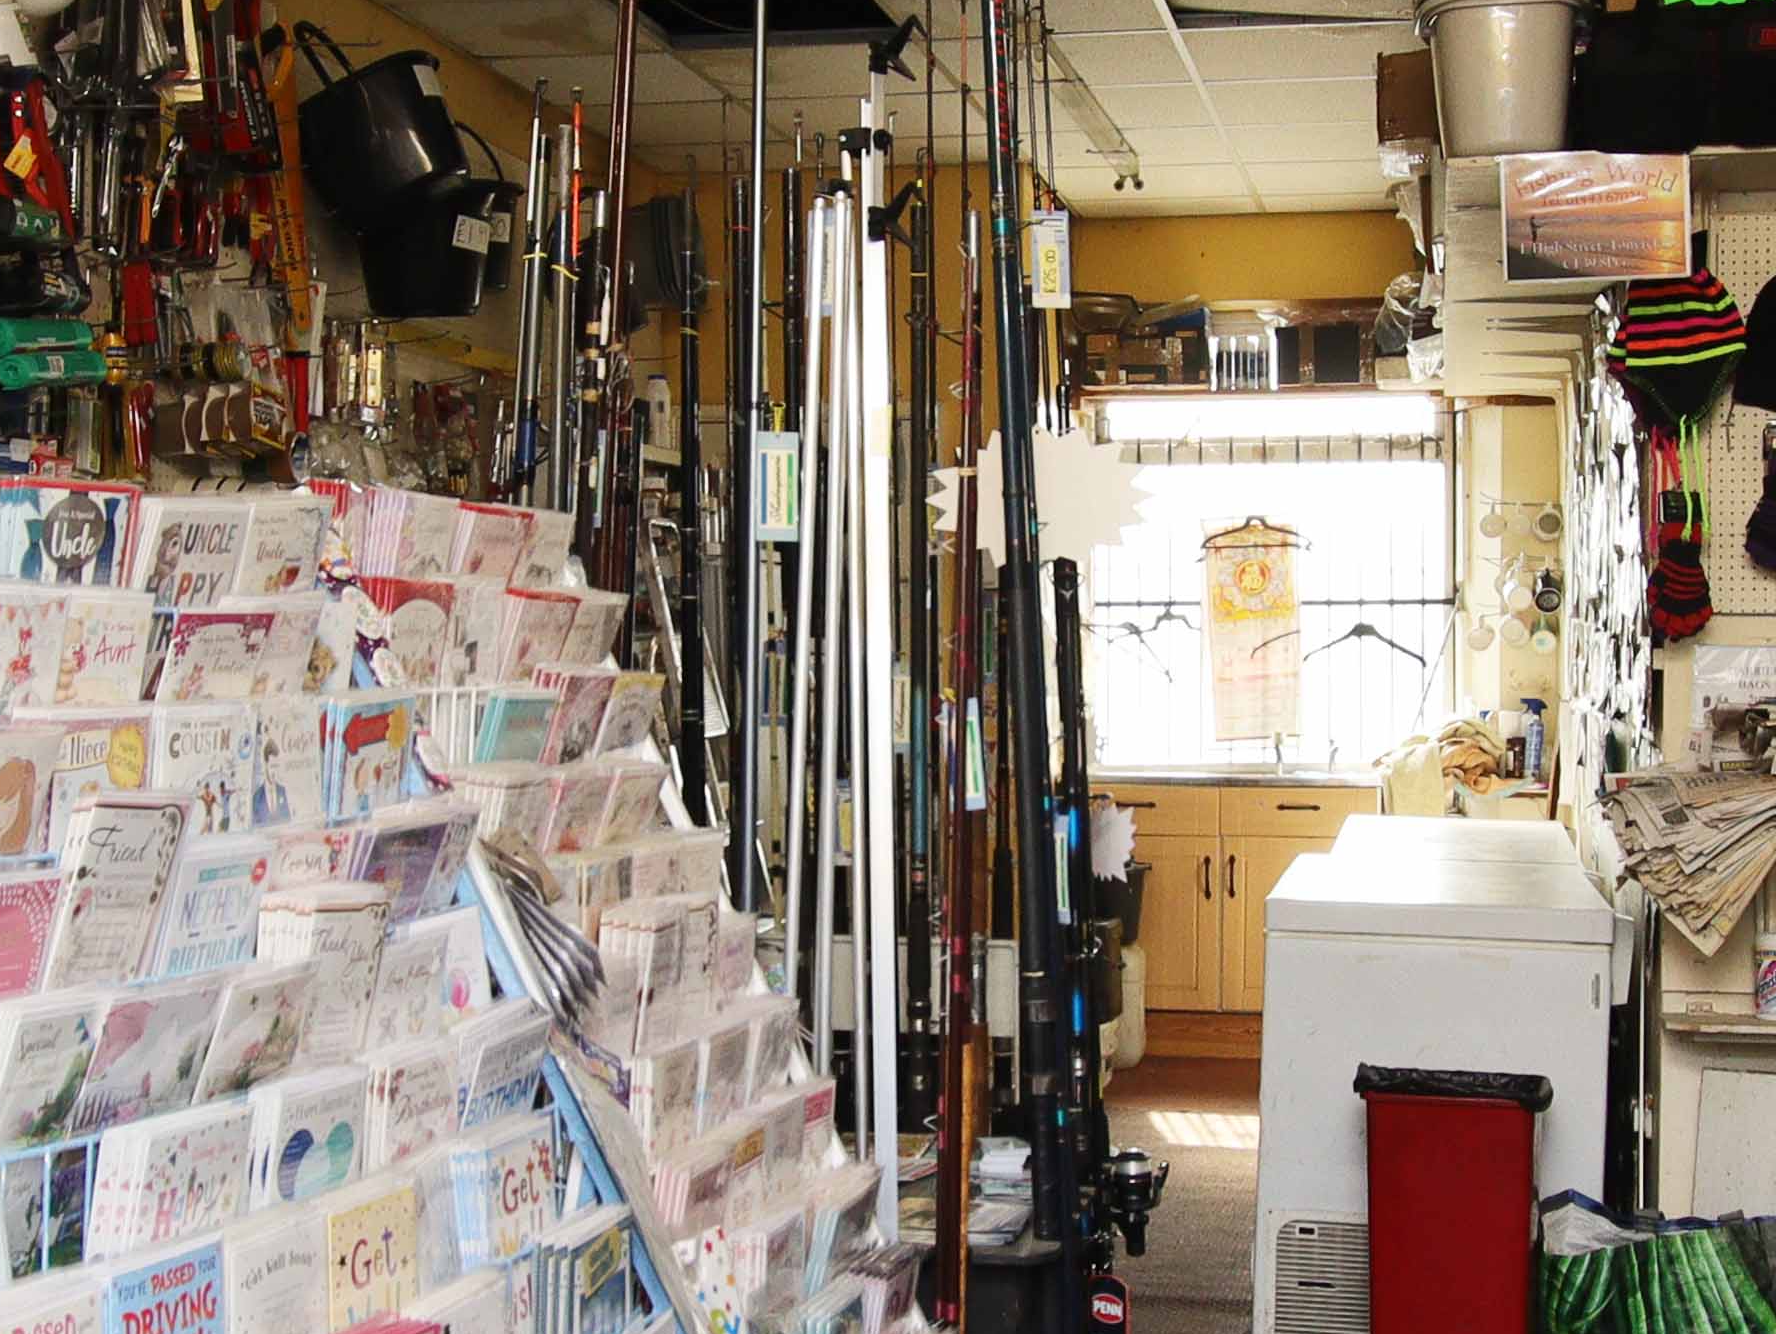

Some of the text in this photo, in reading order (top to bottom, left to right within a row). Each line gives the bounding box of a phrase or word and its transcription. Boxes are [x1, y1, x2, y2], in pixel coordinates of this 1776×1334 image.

[1607, 161, 1680, 193] World
[51, 520, 96, 558] Uncle
[184, 523, 238, 557] UNCLE
[350, 1225, 398, 1290] Get
[1092, 1300, 1123, 1317] PENN
